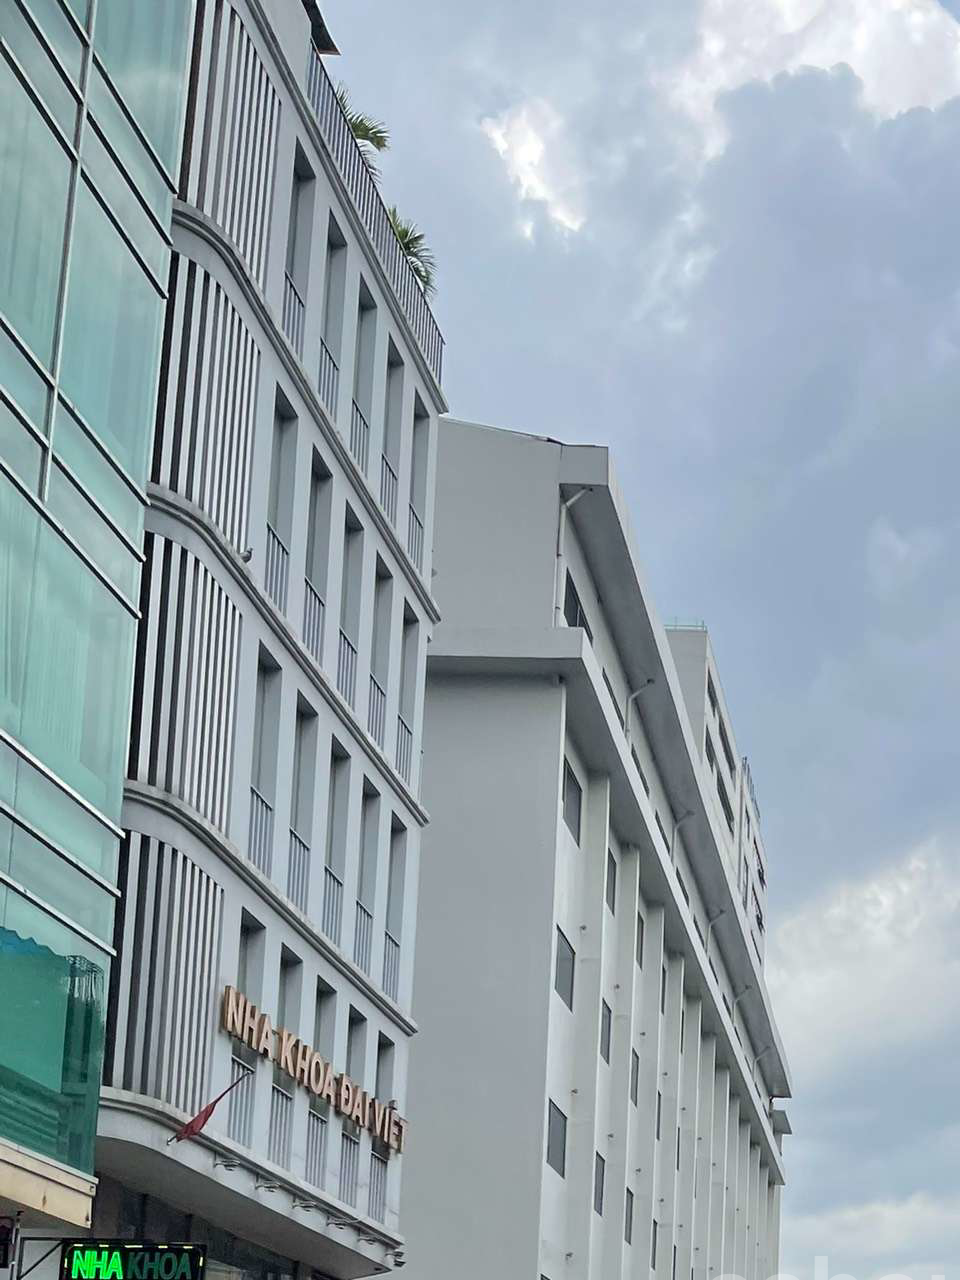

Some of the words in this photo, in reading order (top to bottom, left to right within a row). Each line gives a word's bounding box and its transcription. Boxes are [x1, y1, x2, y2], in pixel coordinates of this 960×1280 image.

[224, 985, 273, 1060] NHA
[278, 1029, 336, 1106] KHOA
[71, 1250, 124, 1280] NHA
[126, 1252, 192, 1280] KHOA
